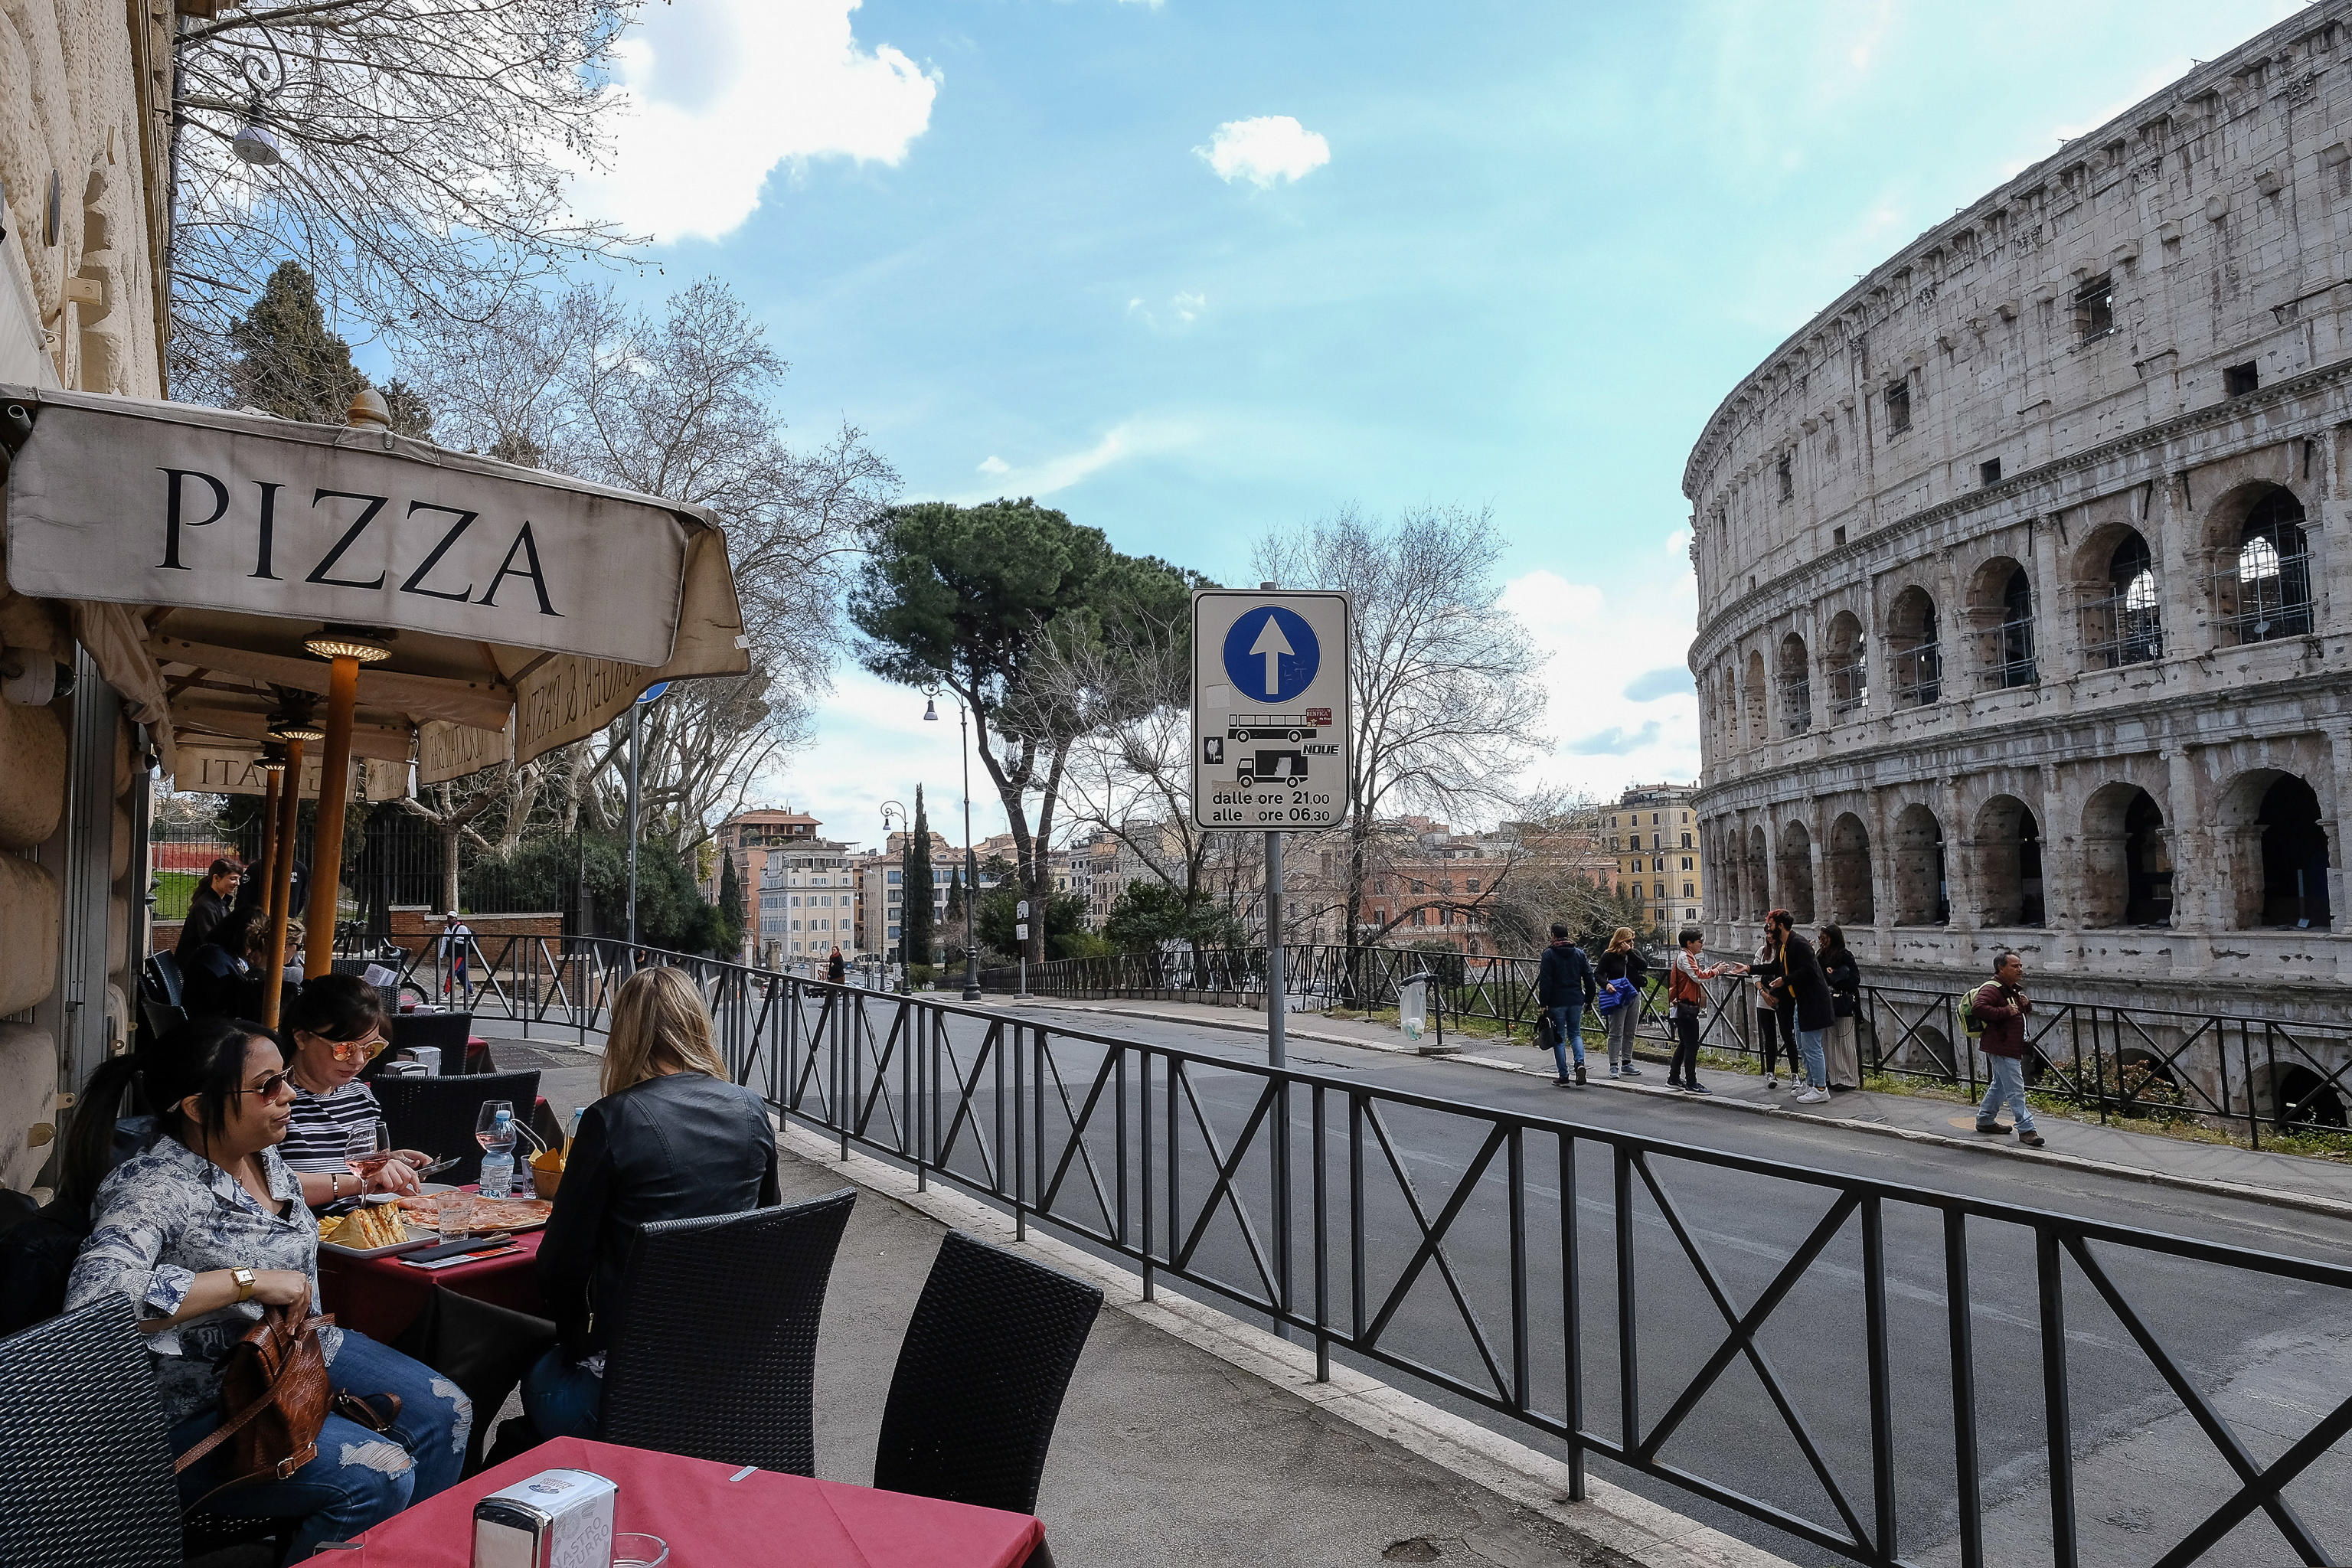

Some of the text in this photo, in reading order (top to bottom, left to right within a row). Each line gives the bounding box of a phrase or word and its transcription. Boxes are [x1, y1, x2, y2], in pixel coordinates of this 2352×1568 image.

[155, 466, 565, 617] PIZZA
[1212, 791, 1253, 805] dalle
[1258, 794, 1283, 805] ore
[1212, 808, 1243, 822] alle
[1258, 811, 1284, 822] ore
[565, 1524, 609, 1568] ZURRO
